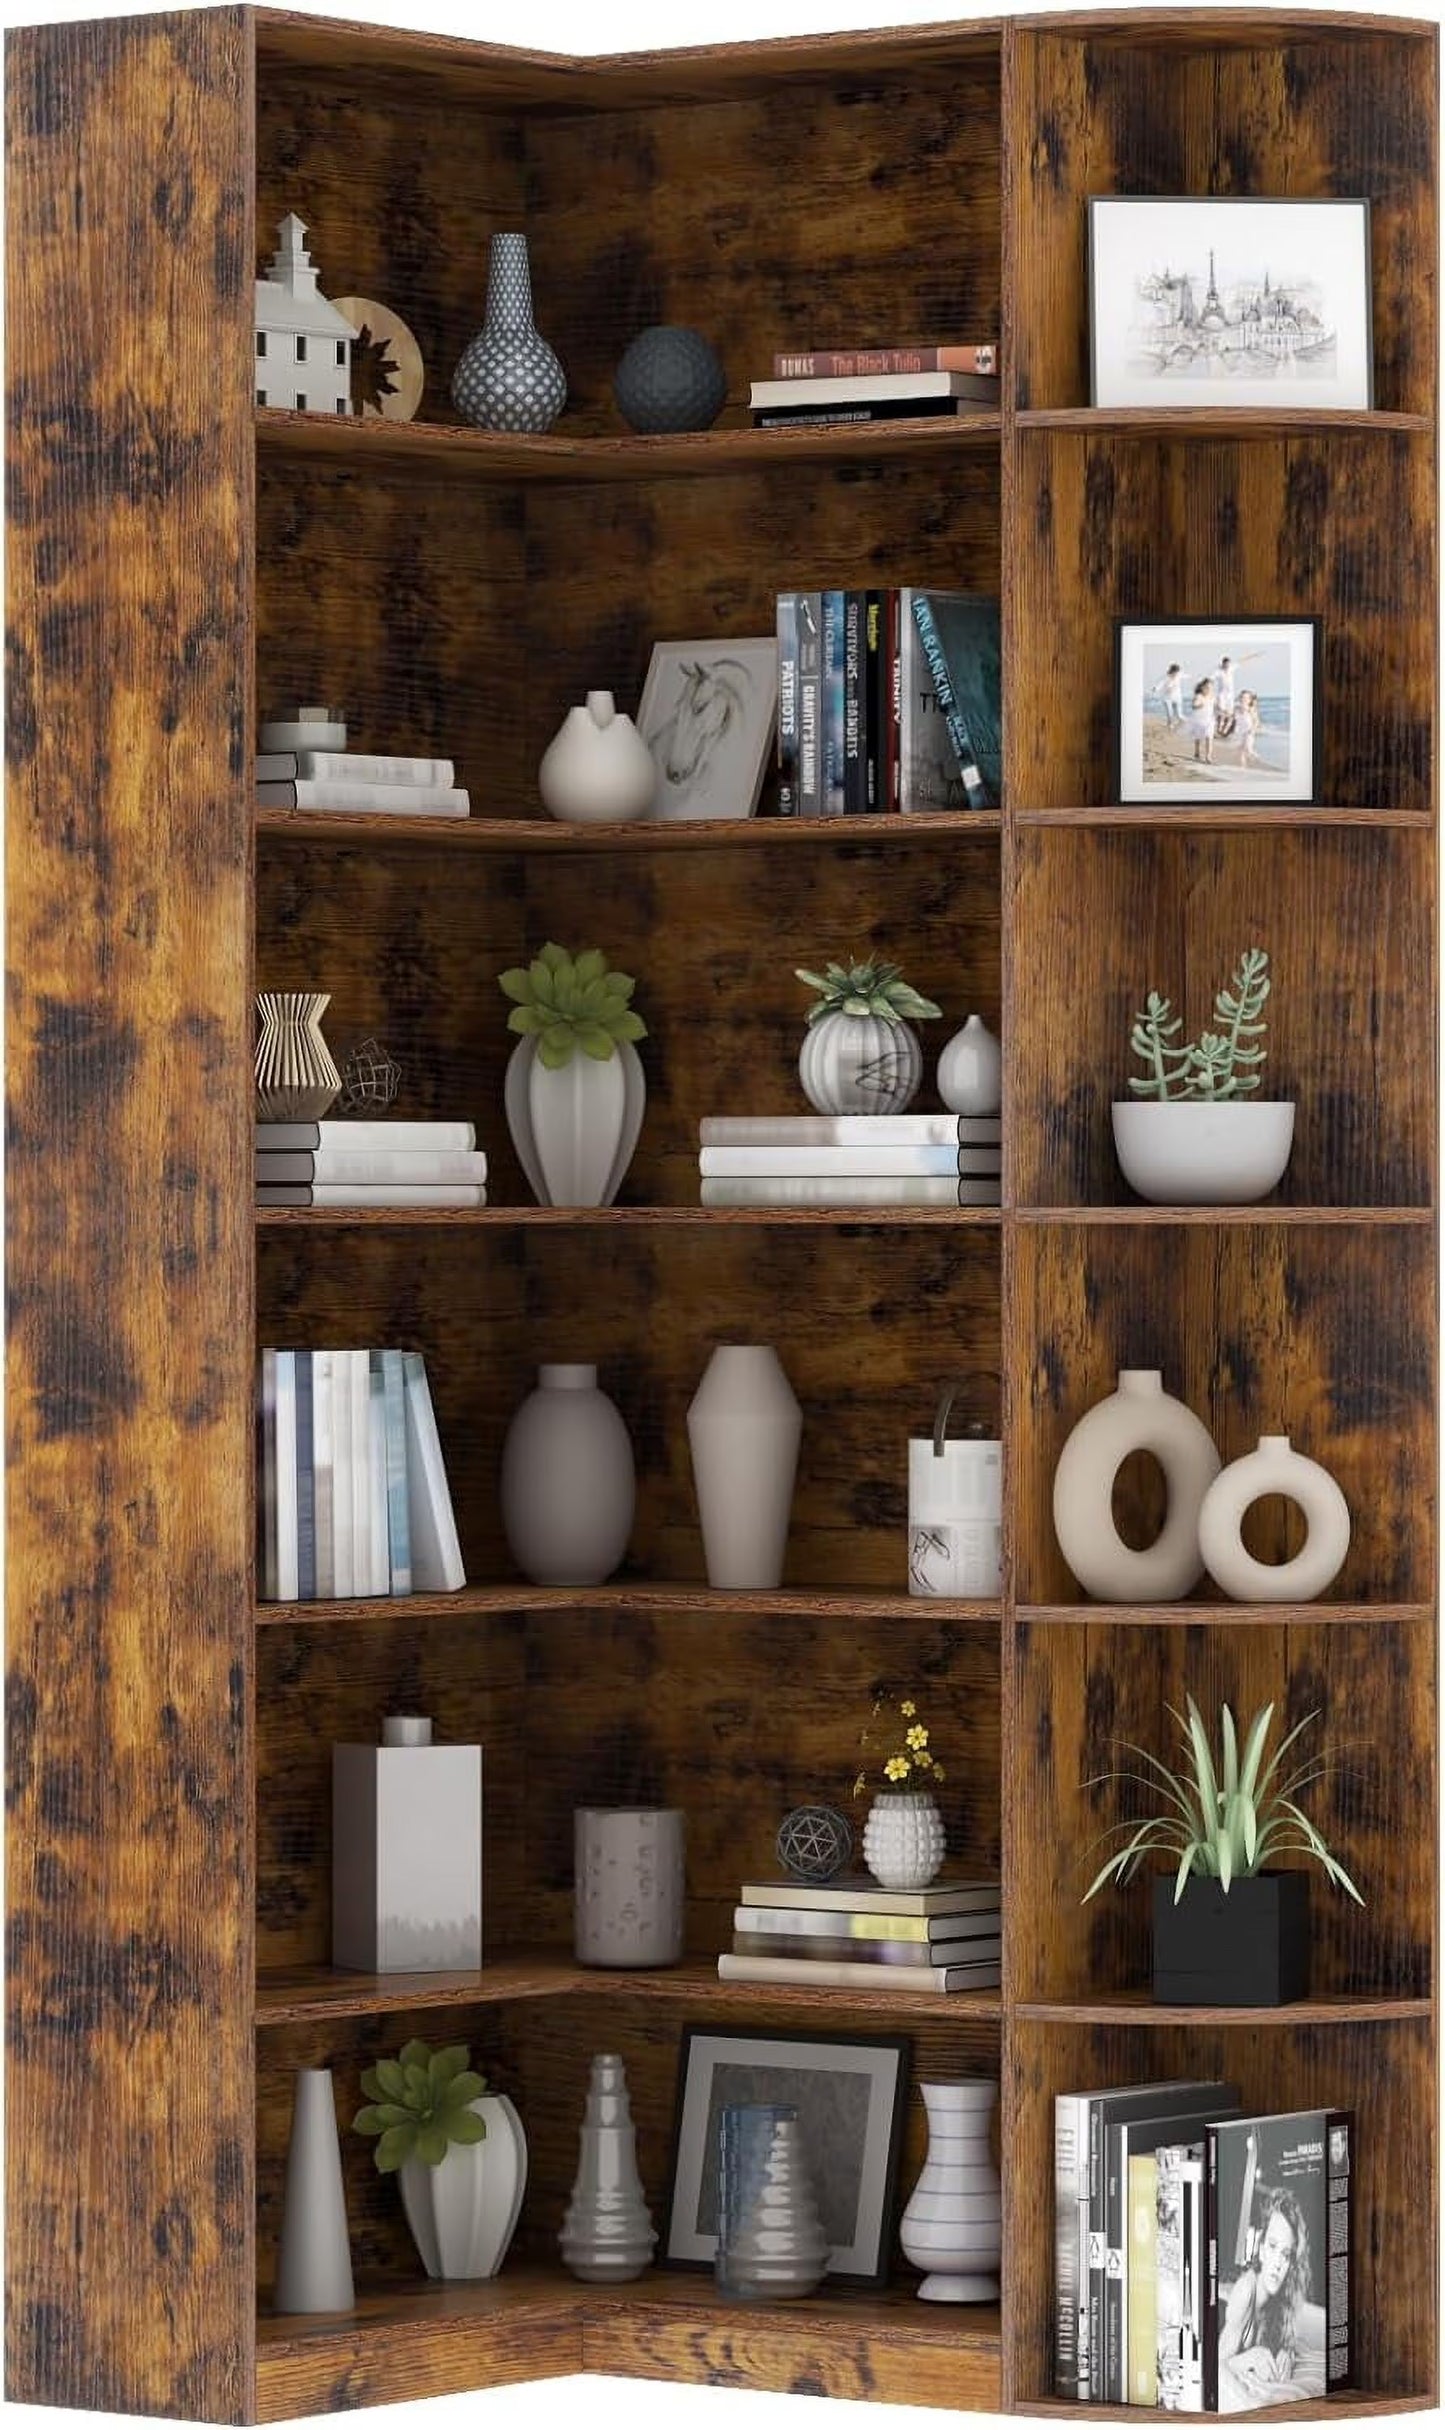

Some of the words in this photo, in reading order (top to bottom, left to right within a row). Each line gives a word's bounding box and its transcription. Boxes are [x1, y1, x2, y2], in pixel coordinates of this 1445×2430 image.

[830, 355, 855, 376] The
[856, 353, 890, 375] Black
[892, 350, 921, 372] Tulip
[912, 596, 931, 637] IAN
[922, 634, 954, 706] RANKIN
[781, 661, 794, 736] PATRIOTS
